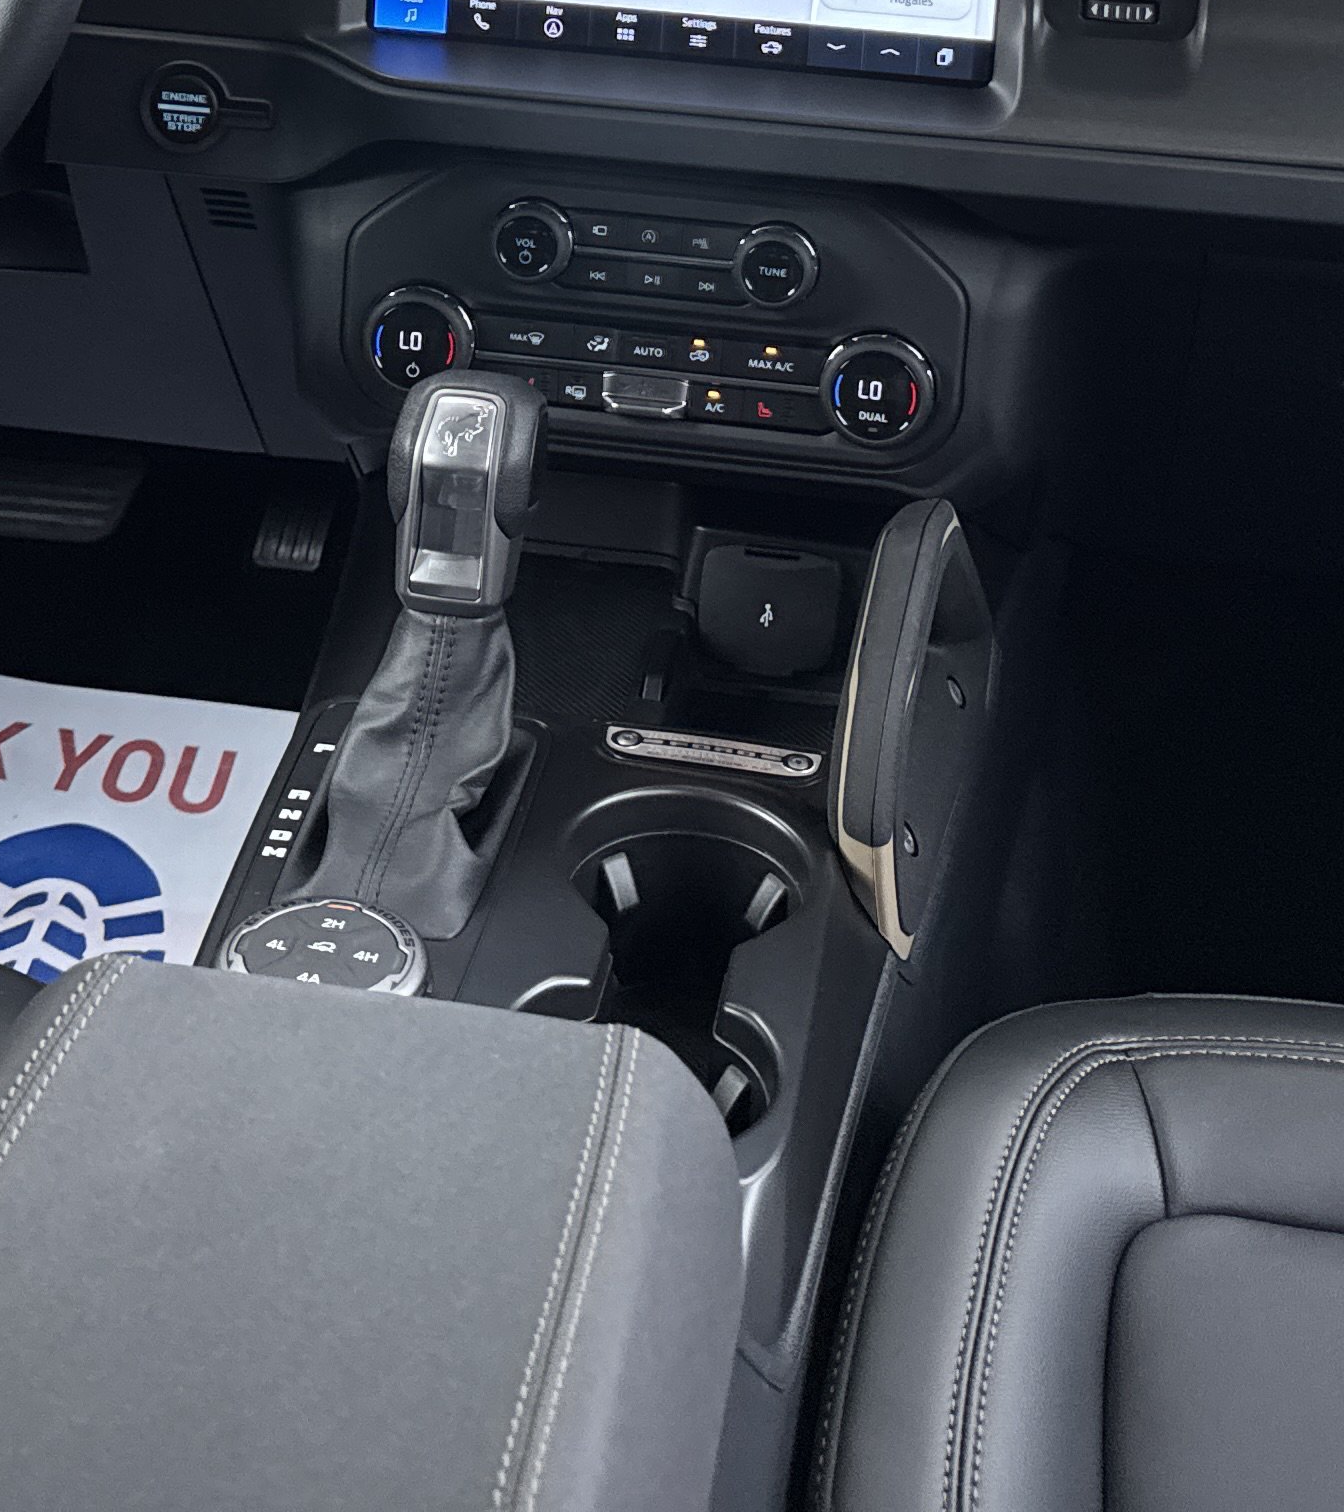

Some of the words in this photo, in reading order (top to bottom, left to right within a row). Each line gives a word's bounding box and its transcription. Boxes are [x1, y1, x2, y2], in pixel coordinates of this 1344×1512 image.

[545, 5, 565, 17] Nav
[615, 11, 638, 25] Apps
[681, 16, 718, 32] Settings
[754, 23, 793, 38] Features
[161, 90, 207, 104] ENGINE
[162, 112, 206, 124] START
[167, 121, 202, 133] STOP
[515, 237, 536, 249] VOL
[758, 265, 788, 278] TUNE
[399, 330, 423, 352] LO
[509, 333, 528, 343] MAX
[633, 345, 664, 358] AUTO
[747, 358, 772, 370] MAX
[774, 361, 795, 373] A/C
[857, 379, 883, 401] LO
[704, 402, 725, 413] A/C
[858, 410, 888, 424] DUAL
[52, 726, 240, 816] YOU
[278, 808, 303, 821] N
[268, 829, 293, 841] D
[261, 845, 288, 858] M
[320, 917, 346, 930] 2H
[265, 938, 287, 951] 4L
[352, 950, 380, 964] 4H
[296, 972, 321, 985] 4A
